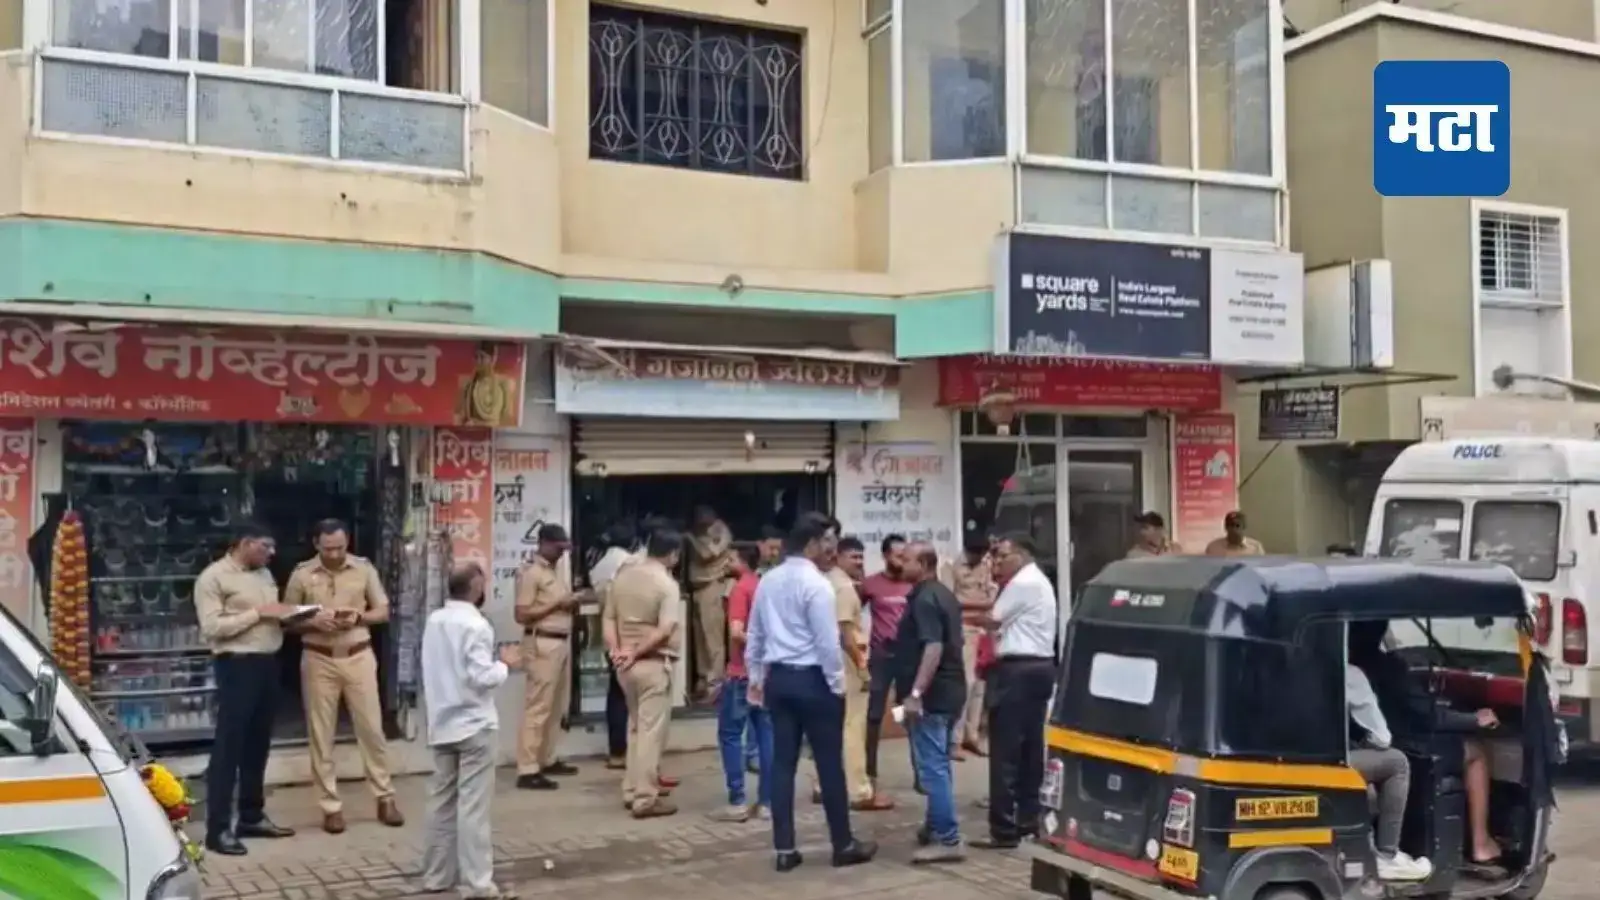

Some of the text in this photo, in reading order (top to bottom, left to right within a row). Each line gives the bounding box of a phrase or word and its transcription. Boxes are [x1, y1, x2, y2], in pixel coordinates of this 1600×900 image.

[1035, 274, 1099, 294] square
[1035, 292, 1088, 314] yards
[1165, 296, 1200, 307] Platform
[140, 325, 443, 388] नॉव्हेल्टीज
[435, 430, 492, 468] शिव
[1453, 444, 1504, 460] POLICE
[861, 478, 924, 505] ज्वेलर्स
